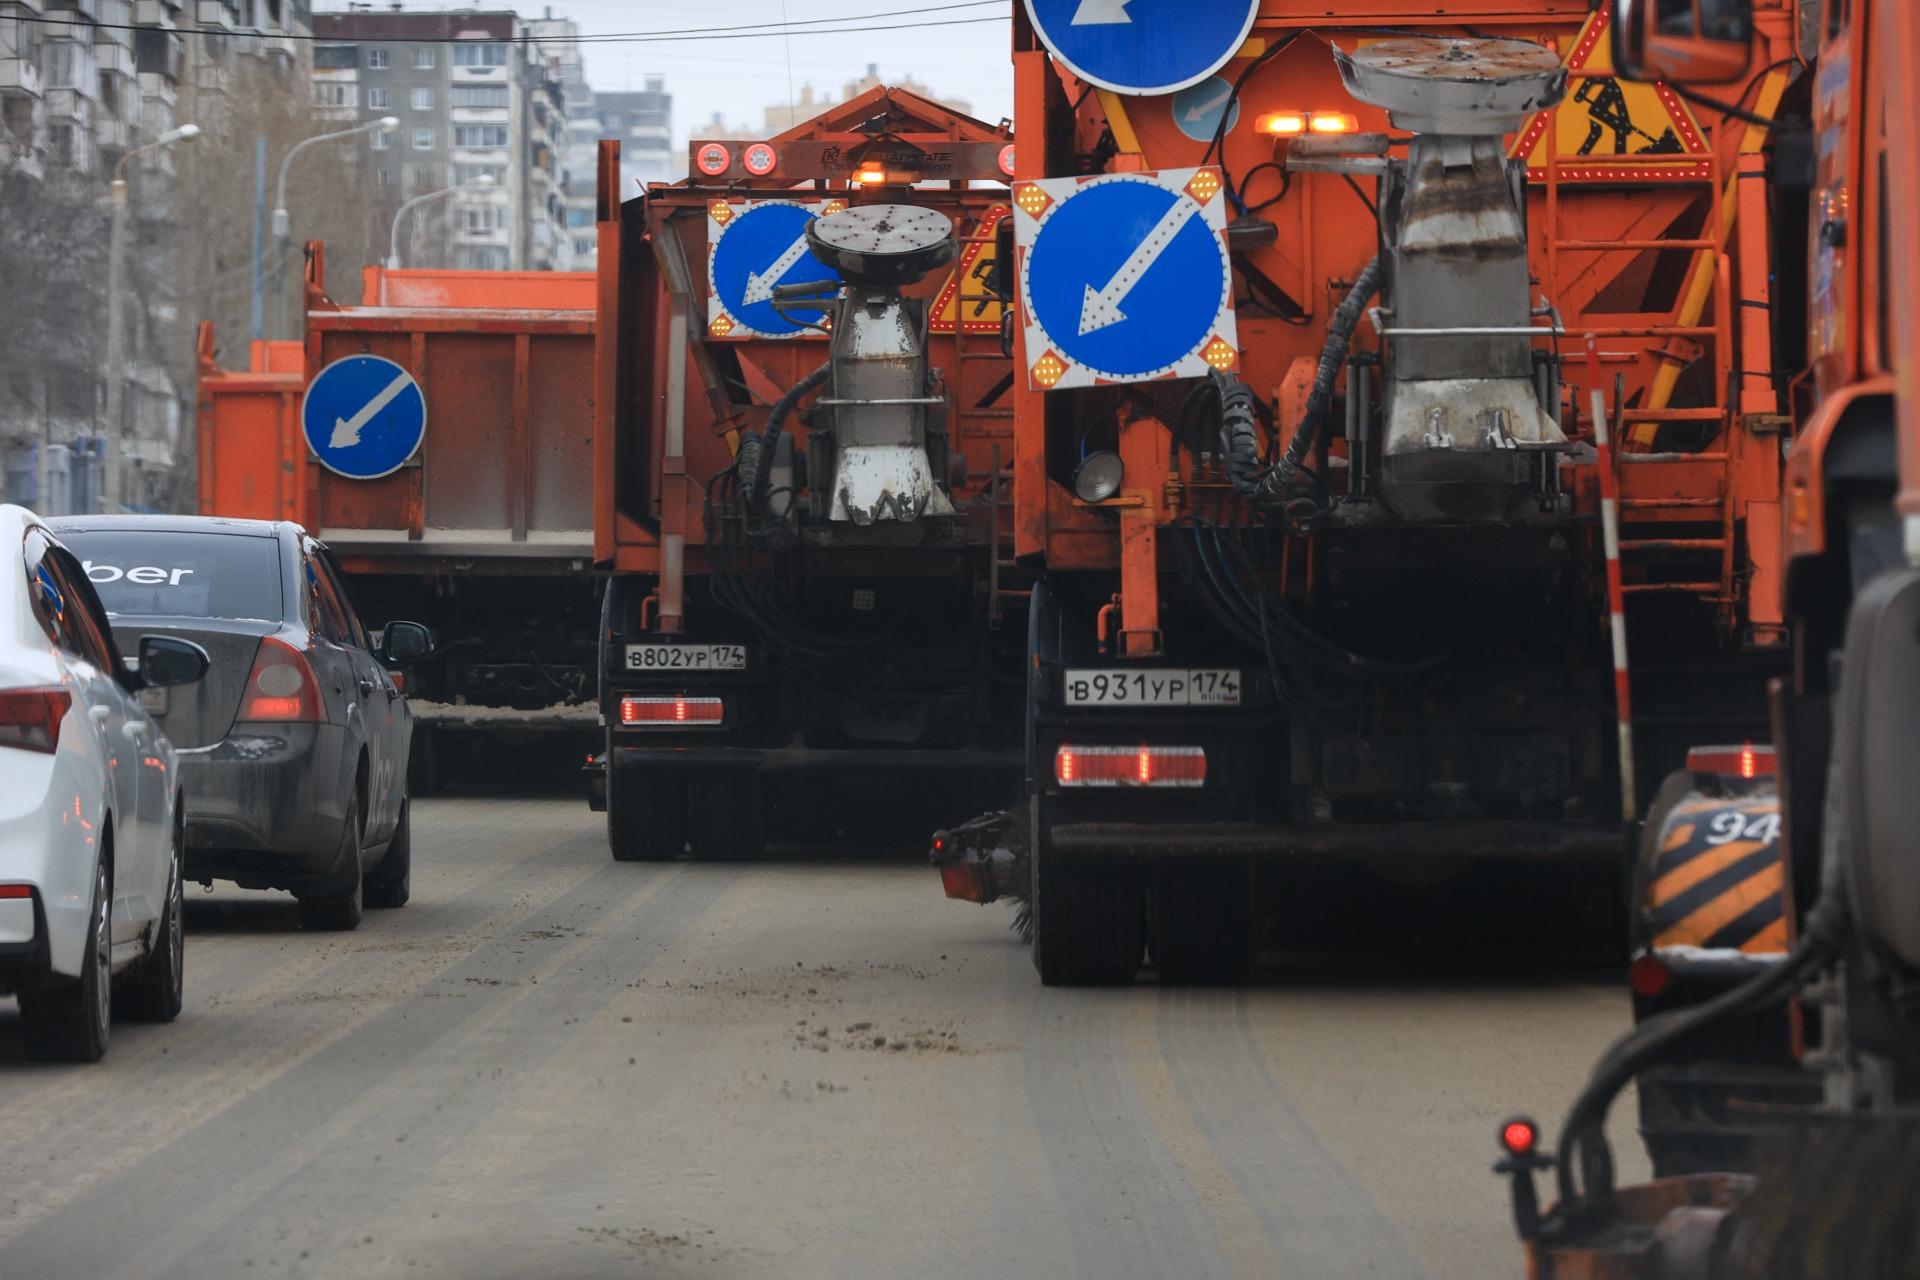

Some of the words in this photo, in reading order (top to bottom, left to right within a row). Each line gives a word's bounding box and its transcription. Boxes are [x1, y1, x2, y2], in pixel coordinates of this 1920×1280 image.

[82, 560, 194, 586] ber
[632, 648, 707, 667] В802УР
[712, 647, 742, 662] 174
[1074, 674, 1184, 701] В931УР
[1193, 673, 1236, 693] 174
